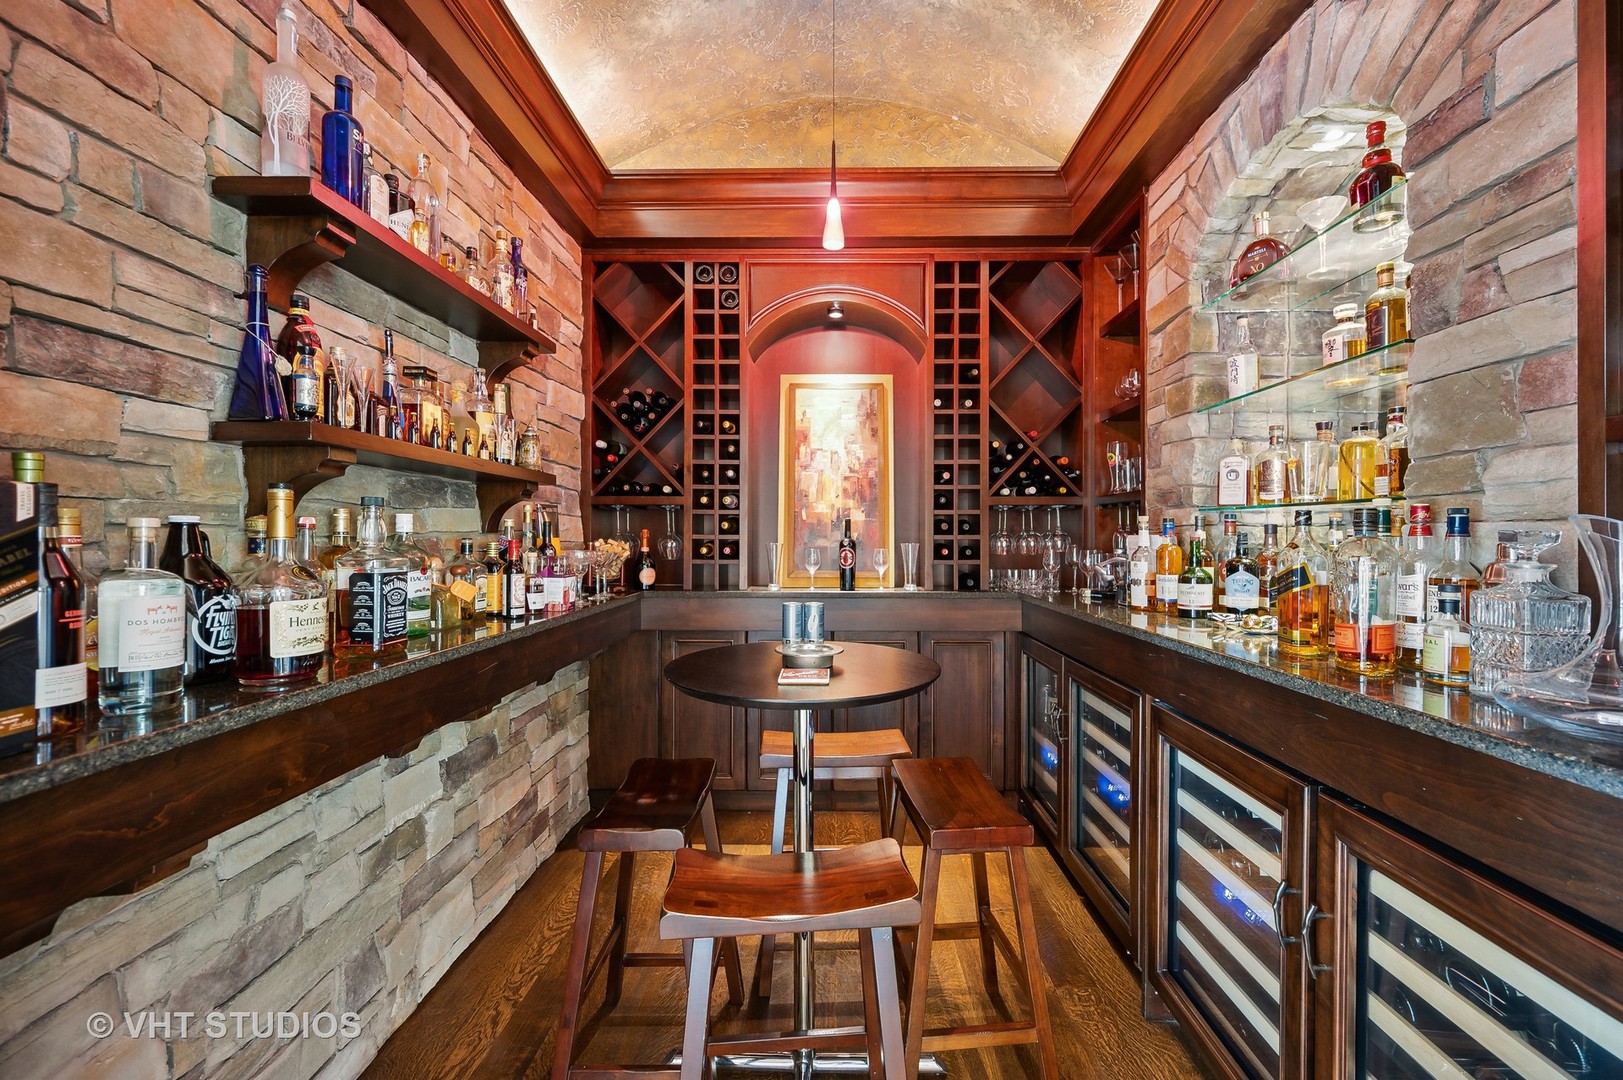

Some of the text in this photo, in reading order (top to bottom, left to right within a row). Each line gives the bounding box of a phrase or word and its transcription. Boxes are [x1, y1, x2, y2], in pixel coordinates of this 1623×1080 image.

[286, 132, 309, 150] BELVE
[1247, 247, 1267, 257] MARTELL
[1250, 262, 1265, 273] XO
[0, 579, 27, 596] DITION
[1429, 605, 1438, 613] 12
